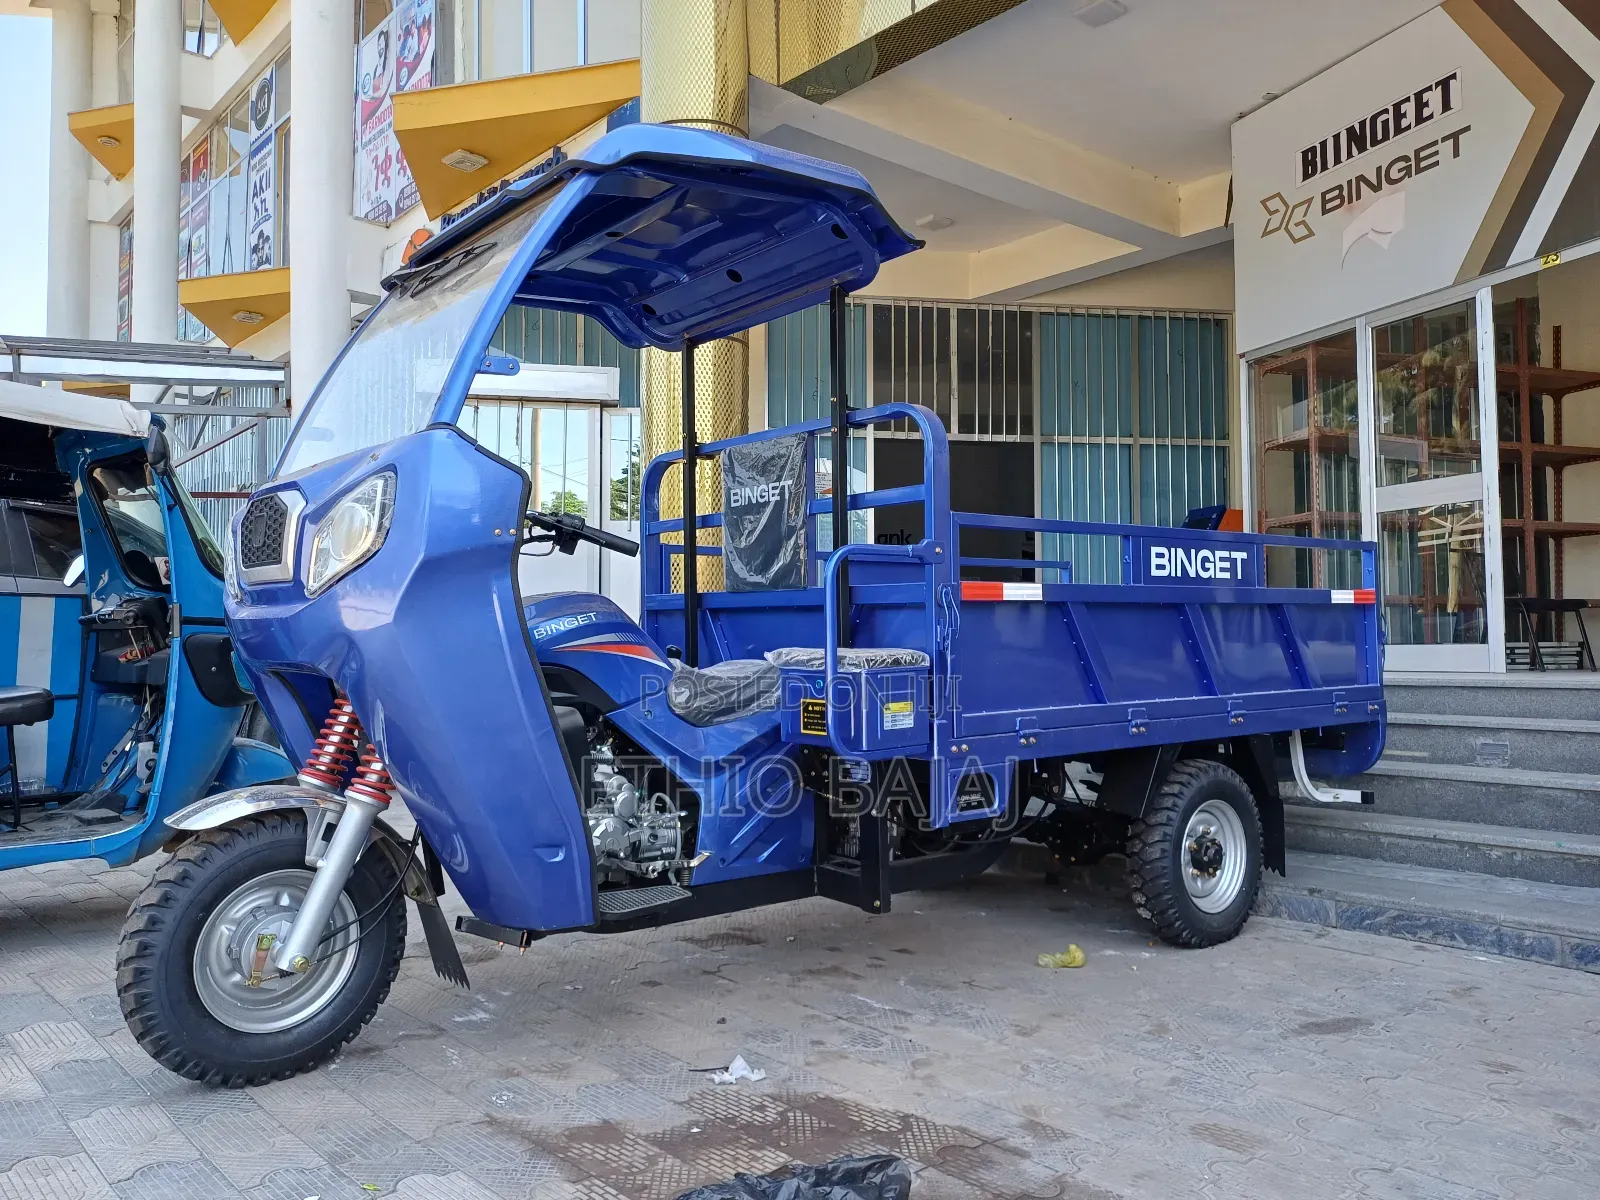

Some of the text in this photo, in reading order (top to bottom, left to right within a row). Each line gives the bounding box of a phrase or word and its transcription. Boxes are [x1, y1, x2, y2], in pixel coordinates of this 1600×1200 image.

[1300, 71, 1458, 184] BIINGEET
[1320, 124, 1472, 217] BINGET
[730, 480, 793, 508] BINGET
[1150, 545, 1248, 580] BINGET
[533, 612, 597, 640] BINGET
